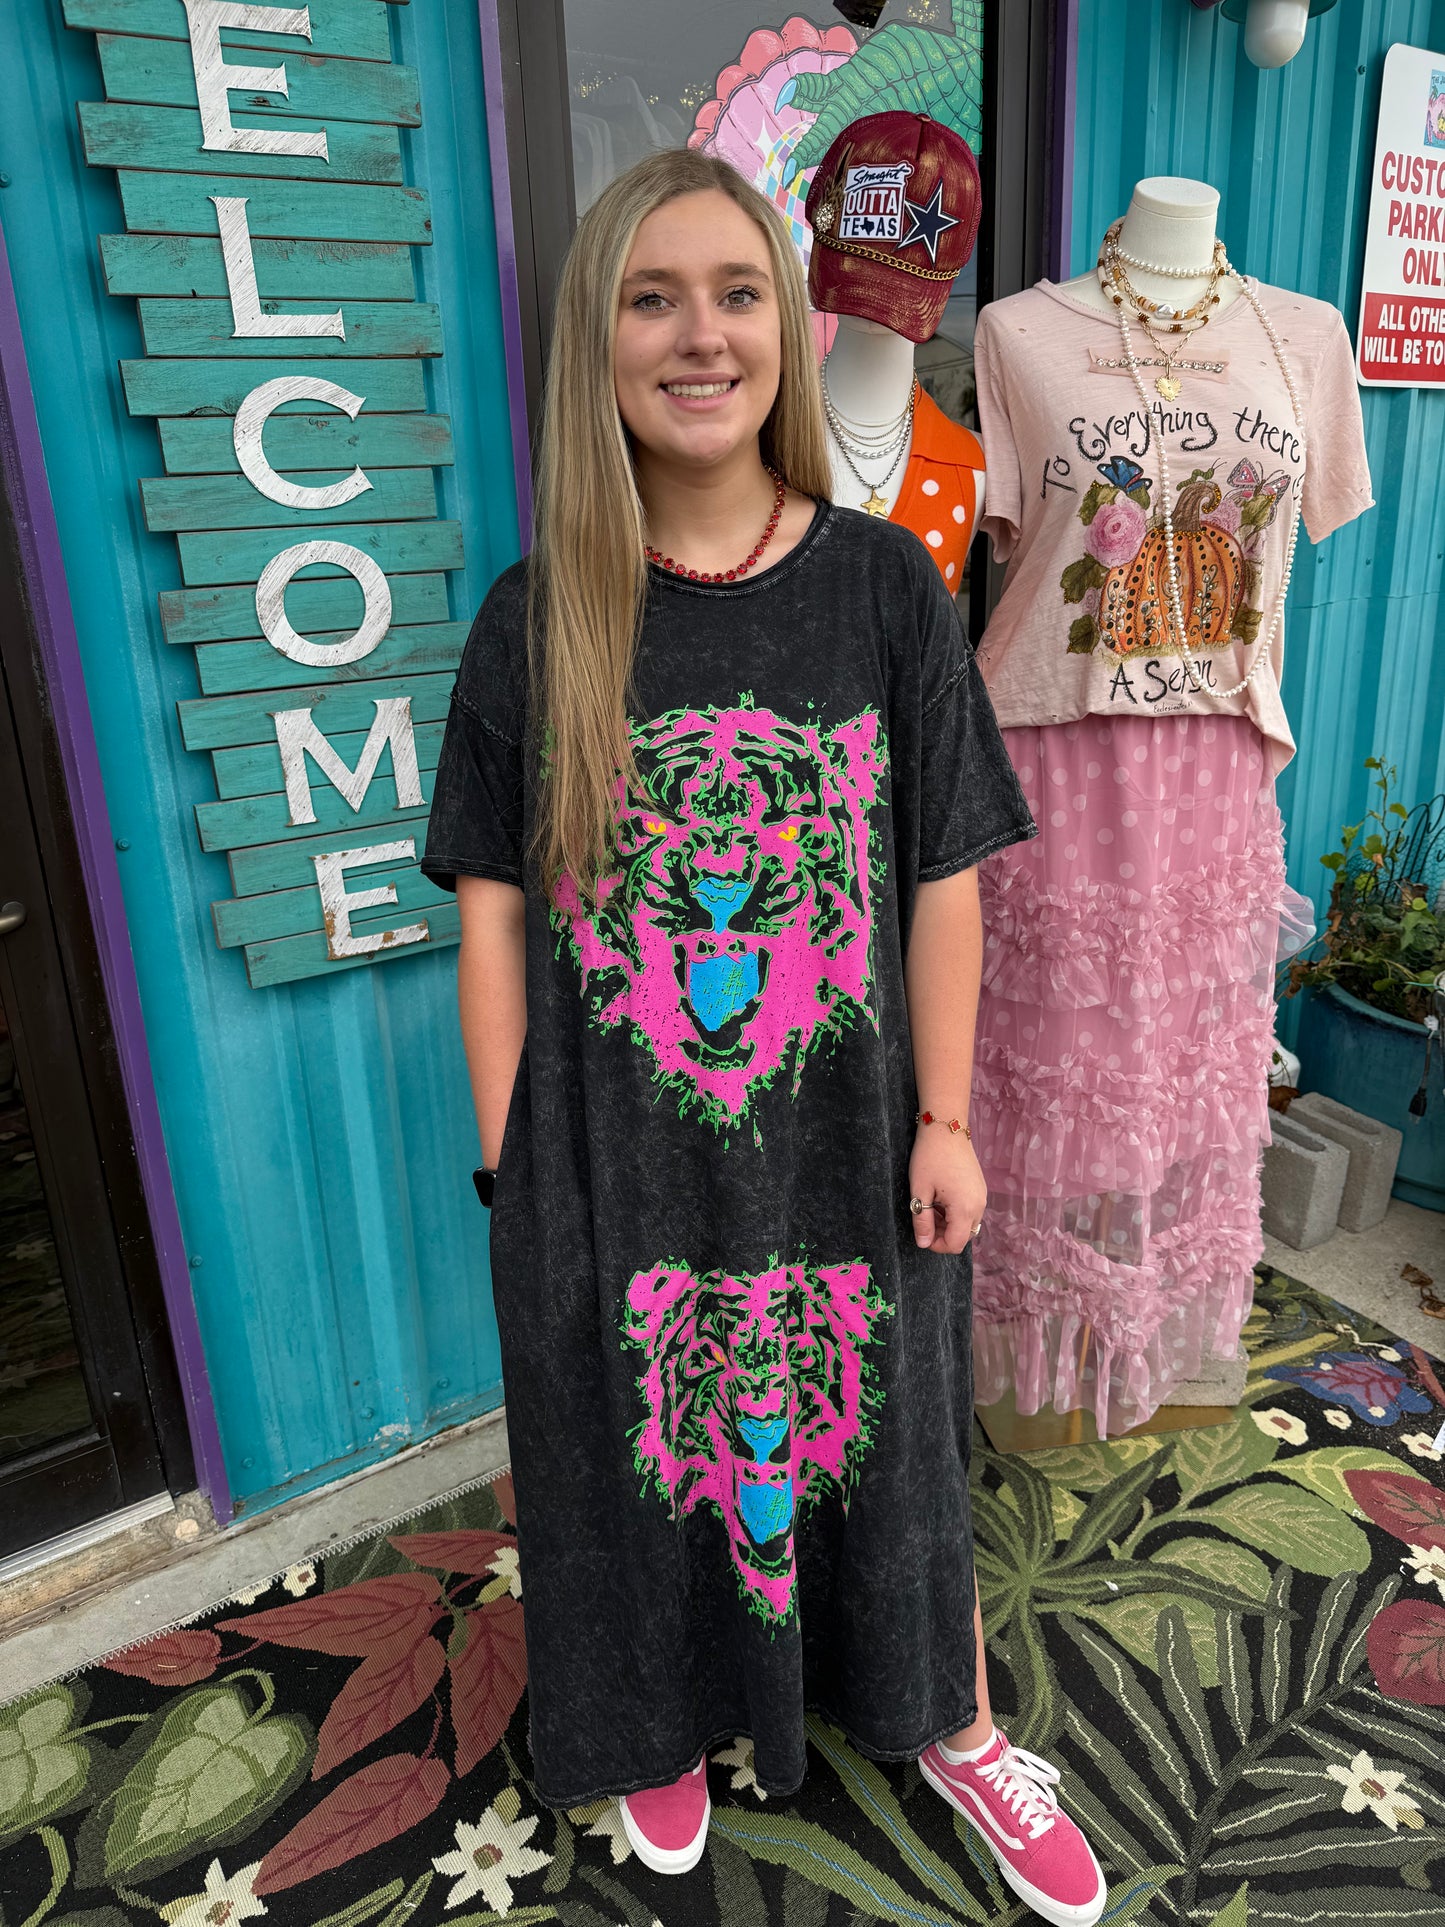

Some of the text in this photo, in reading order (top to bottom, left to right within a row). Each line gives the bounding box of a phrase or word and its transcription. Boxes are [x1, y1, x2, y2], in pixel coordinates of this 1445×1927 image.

[847, 165, 910, 188] Straight
[846, 189, 898, 215] OUTTA
[843, 216, 898, 237] TEAS
[1402, 247, 1445, 288] ONL
[1377, 303, 1445, 334] ALL OTHE
[1364, 336, 1445, 366] WILL BE TO
[1040, 401, 1301, 500] To Everything there
[183, 0, 428, 960] ELCOME
[1109, 659, 1218, 704] A SeAn
